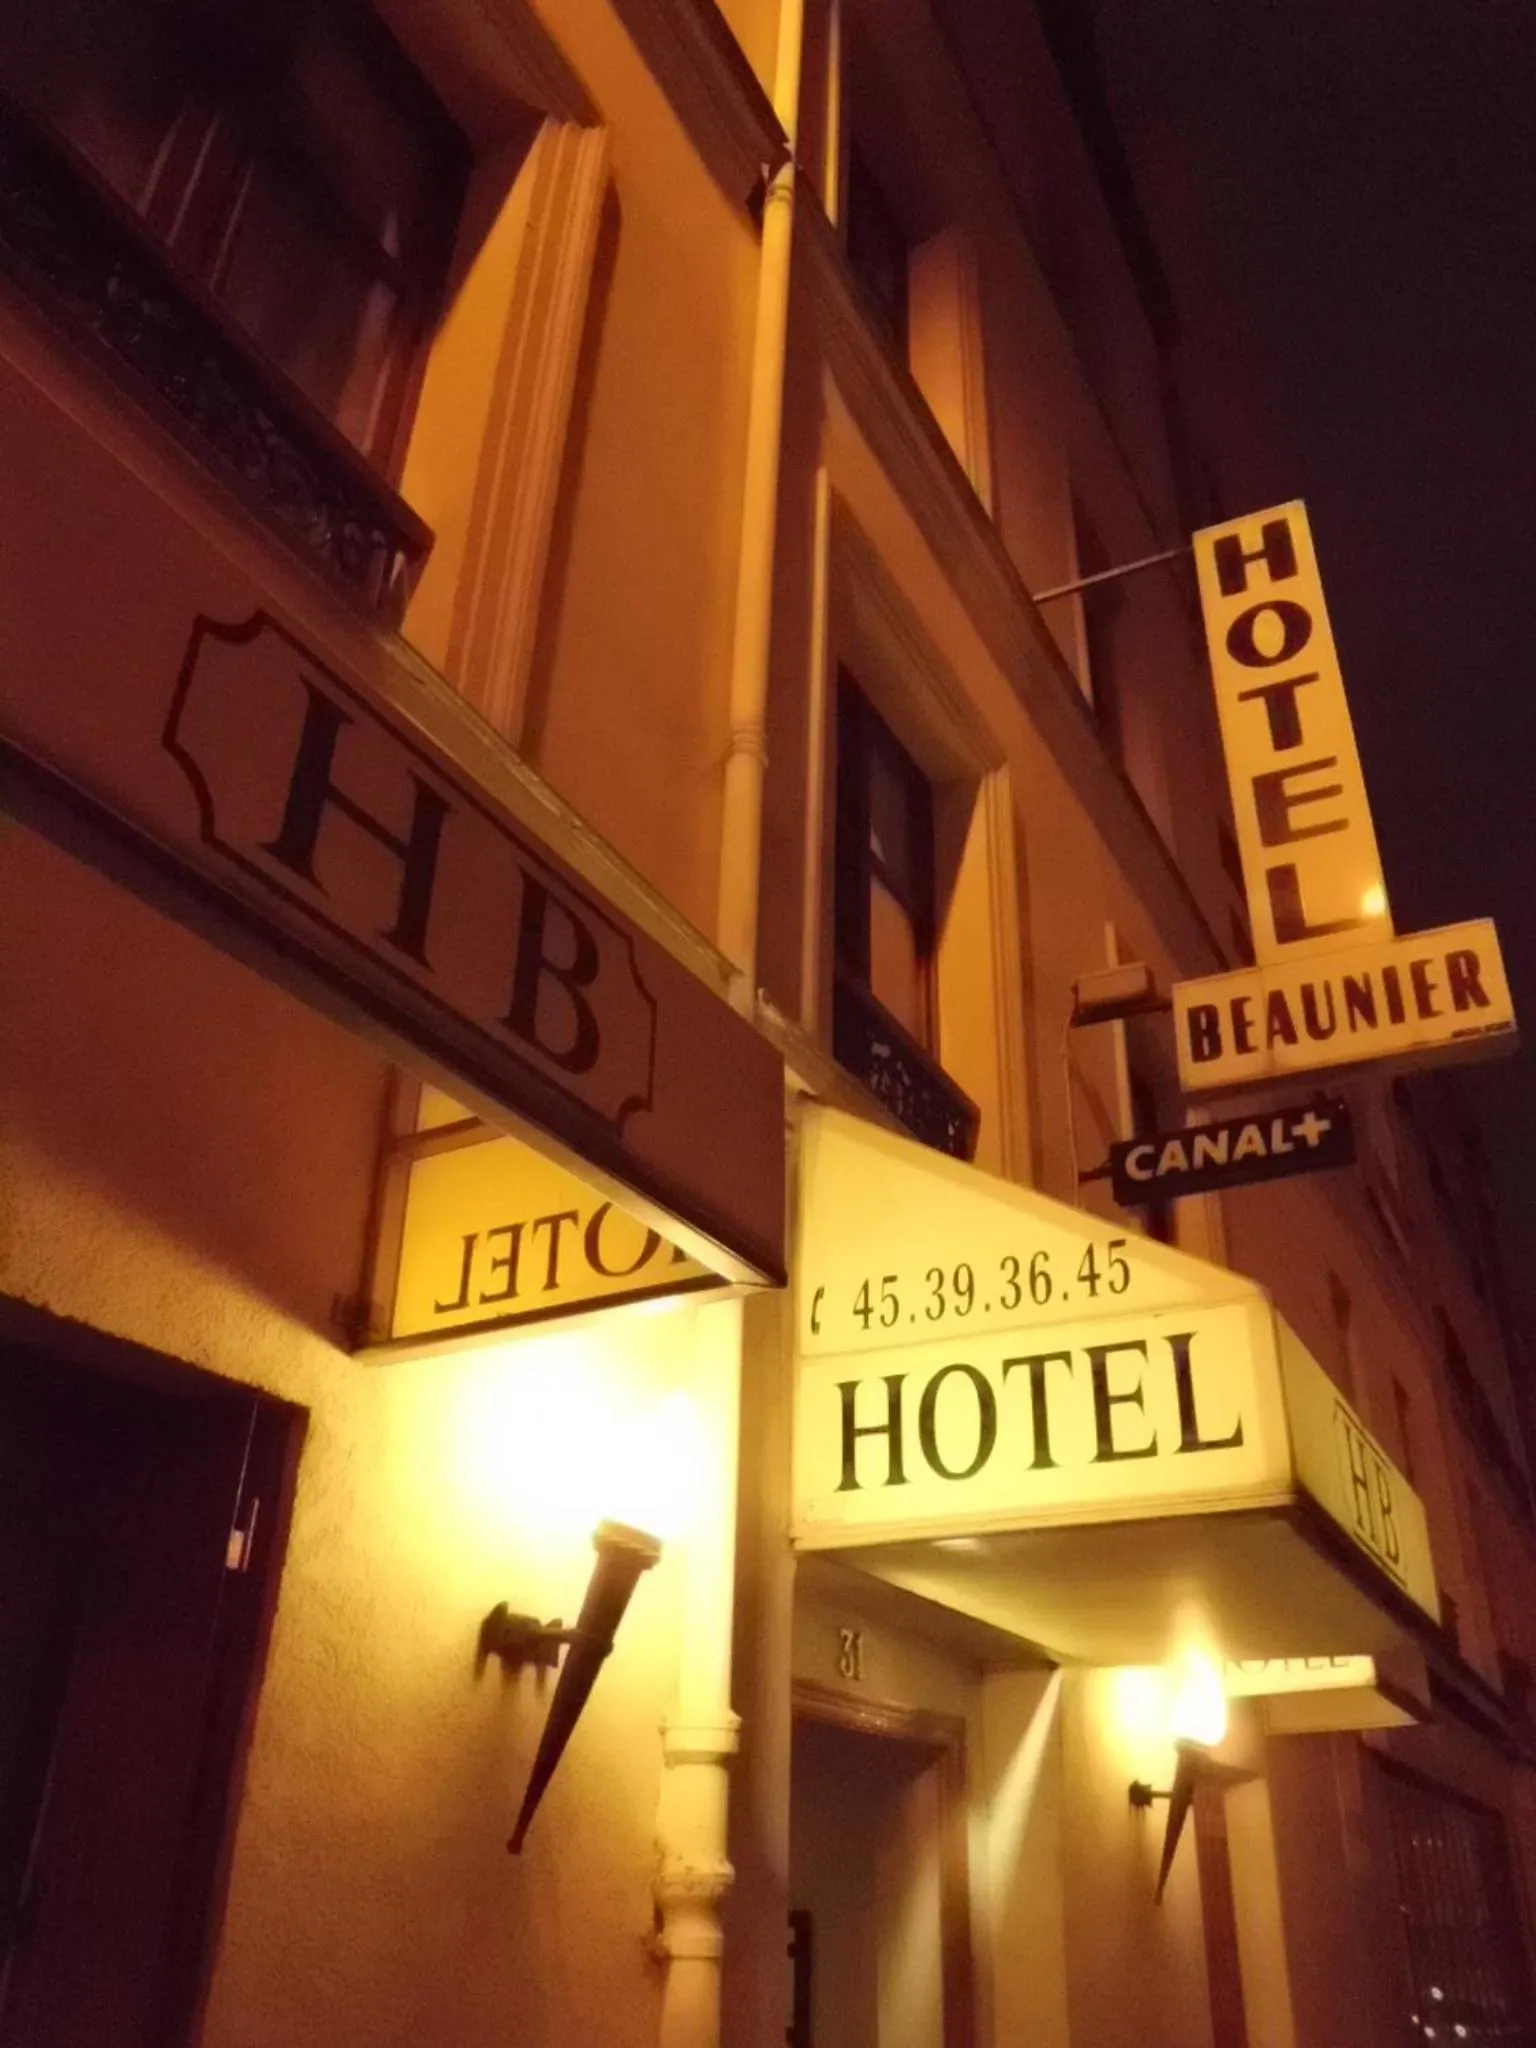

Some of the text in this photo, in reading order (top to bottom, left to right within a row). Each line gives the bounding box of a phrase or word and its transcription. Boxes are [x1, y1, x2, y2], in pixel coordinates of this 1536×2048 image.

[1213, 517, 1367, 945] HOTEL
[255, 677, 600, 1076] HB
[1187, 948, 1491, 1063] BEAUNIER
[1124, 1111, 1331, 1182] CANAL+
[853, 1239, 1131, 1330] 45.39.36.45
[834, 1331, 1244, 1493] HOTEL
[1343, 1419, 1400, 1565] HB
[838, 1627, 865, 1680] 31
